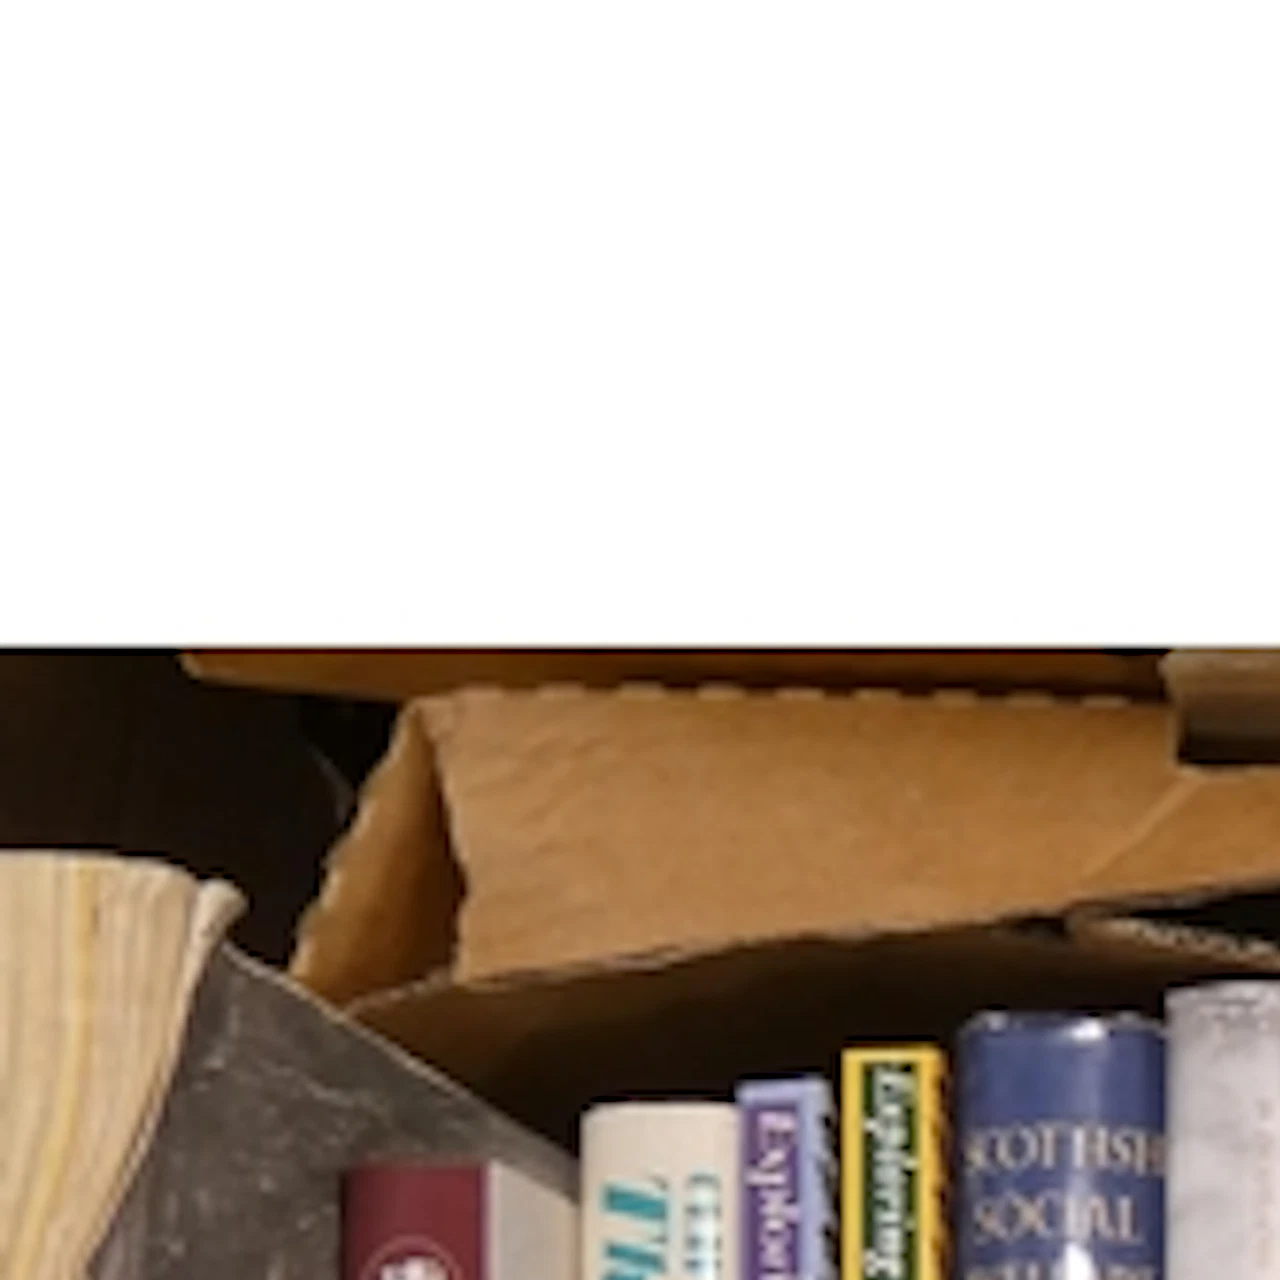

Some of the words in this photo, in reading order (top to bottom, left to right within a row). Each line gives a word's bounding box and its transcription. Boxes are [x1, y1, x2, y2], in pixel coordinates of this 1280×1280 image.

[863, 1070, 917, 1280] Exploring
[962, 1123, 1164, 1176] SCOTTISH
[973, 1194, 1144, 1243] SOCIAL
